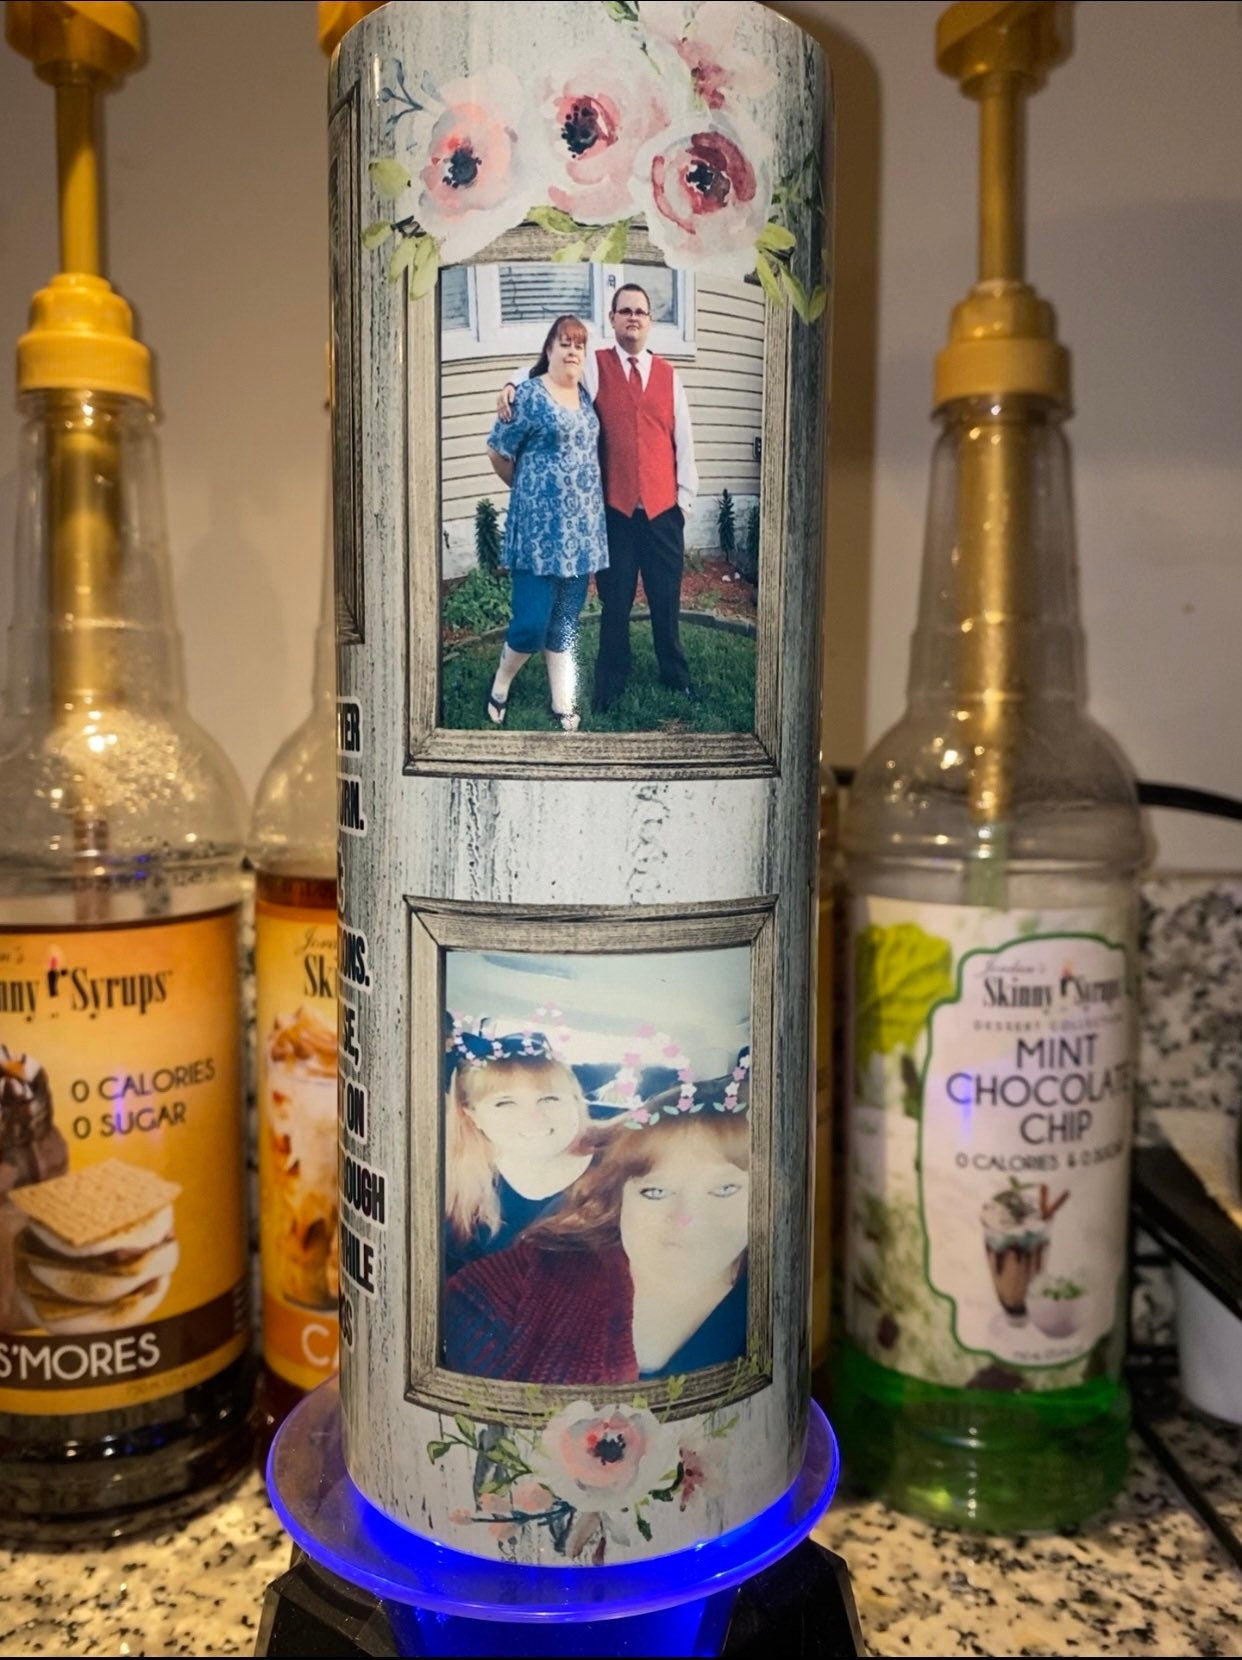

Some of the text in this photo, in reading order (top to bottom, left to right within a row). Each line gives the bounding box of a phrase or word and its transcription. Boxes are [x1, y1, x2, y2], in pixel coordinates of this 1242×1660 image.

[72, 966, 168, 1016] Syrups
[983, 976, 1052, 1016] Skinny
[1016, 1033, 1099, 1069] MINT
[98, 1057, 216, 1101] CALORIES
[101, 1102, 187, 1138] SUGAR
[1020, 1110, 1093, 1145] CHIP
